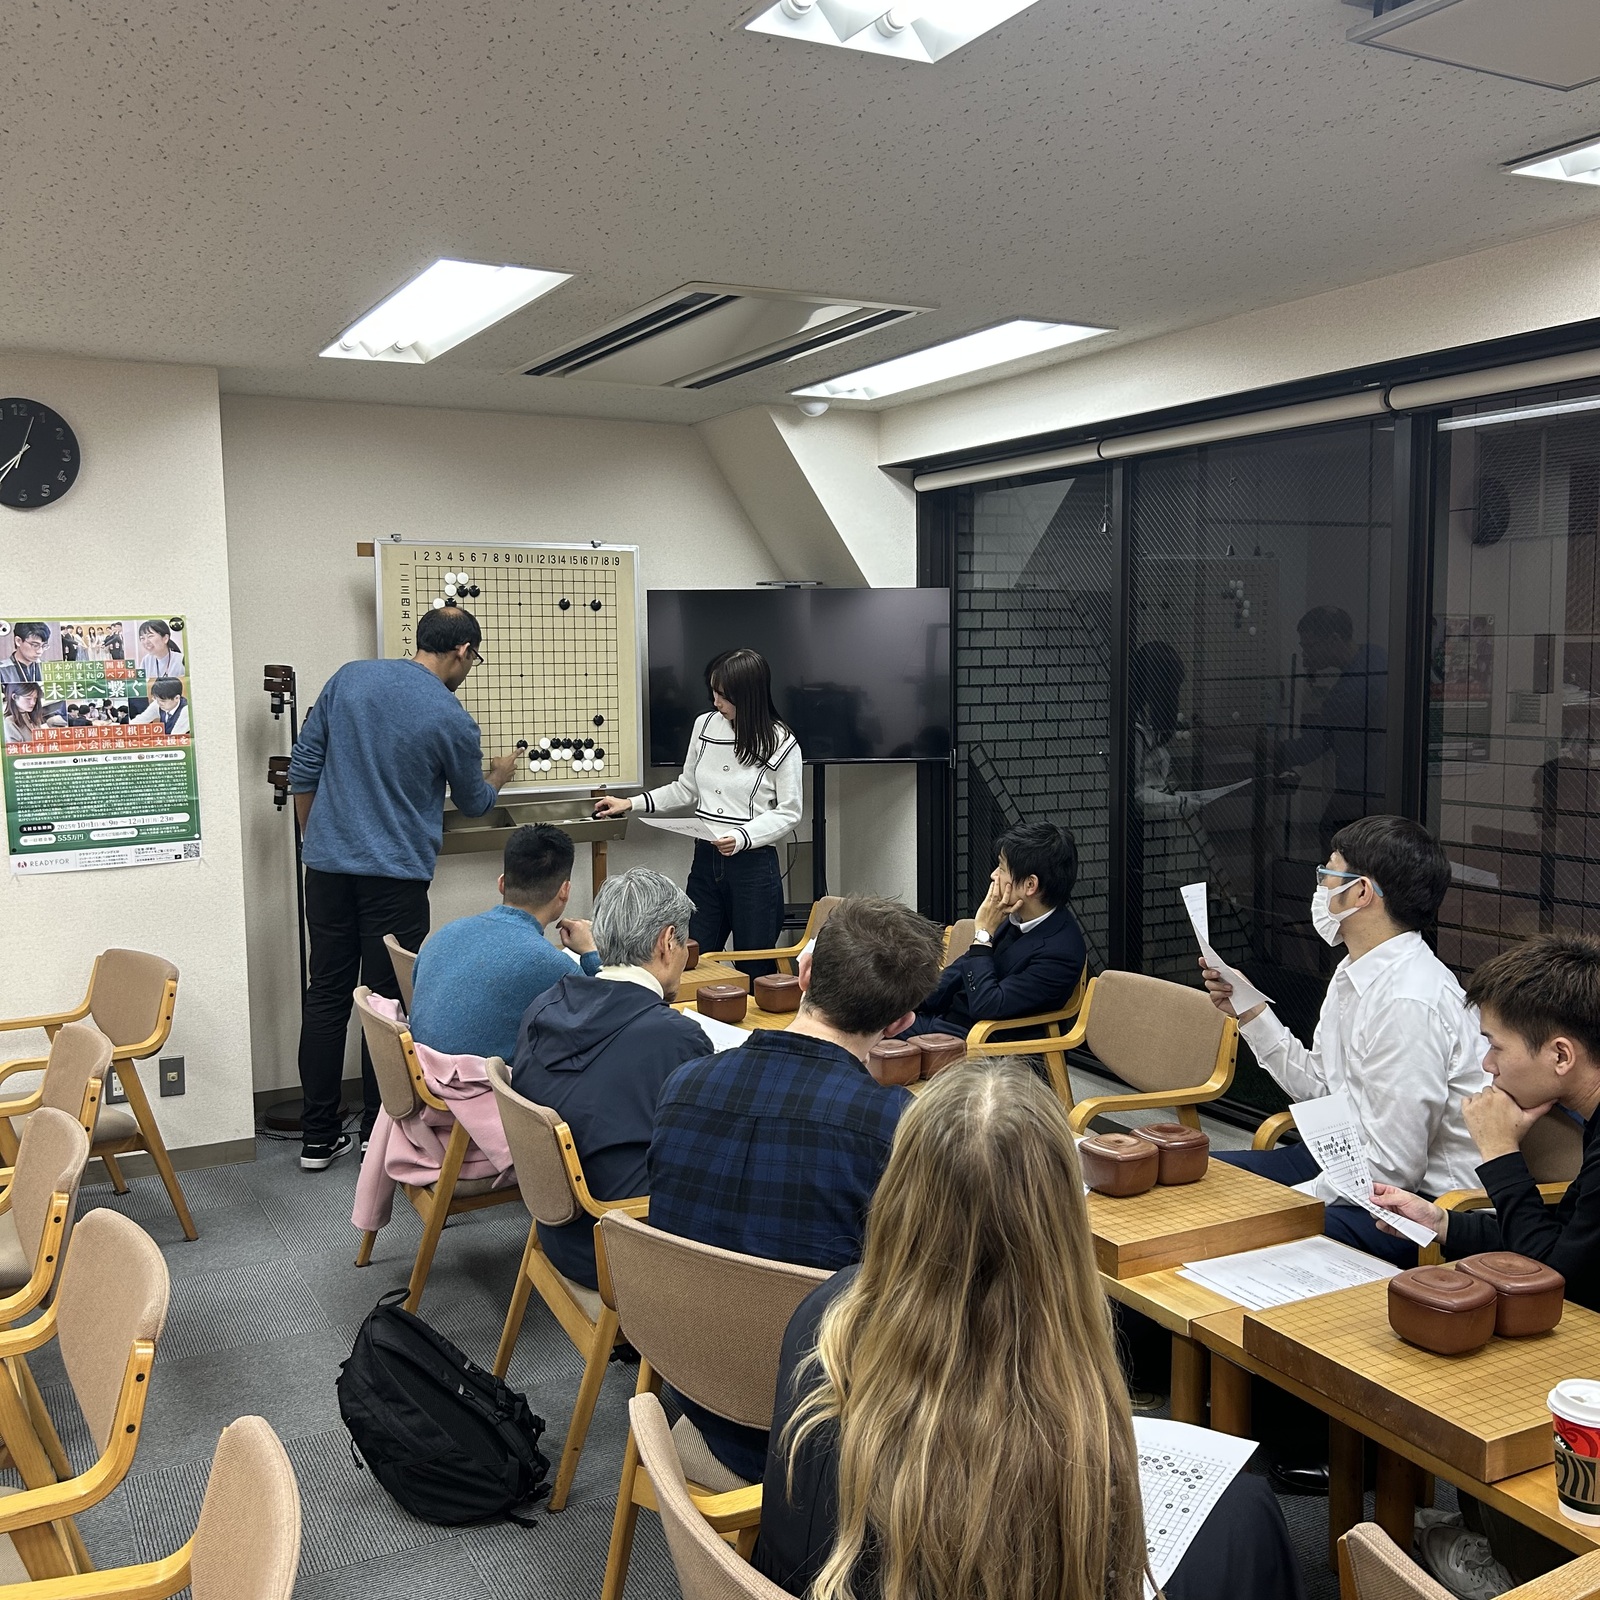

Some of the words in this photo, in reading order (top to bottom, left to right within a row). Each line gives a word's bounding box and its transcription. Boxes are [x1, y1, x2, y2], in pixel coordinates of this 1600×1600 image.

[11, 404, 28, 416] 12
[55, 427, 64, 440] 2
[62, 449, 72, 462] 3
[57, 470, 67, 482] 4
[18, 489, 28, 501] 6
[41, 484, 51, 497] 5
[424, 552, 430, 560] 2
[436, 552, 441, 561] 3
[448, 552, 452, 560] 4
[460, 552, 464, 562] 5
[471, 552, 476, 562] 6
[482, 553, 487, 562] 7
[494, 553, 499, 562] 8
[505, 553, 510, 562] 9
[515, 554, 523, 563] 10
[526, 554, 533, 563] 11
[537, 554, 545, 564] 12
[548, 555, 556, 564] 13
[558, 555, 566, 564] 14
[570, 556, 578, 564] 15
[581, 556, 588, 565] 16
[591, 556, 598, 565] 17
[602, 557, 609, 565] 18
[612, 557, 620, 566] 19
[400, 586, 410, 594] 三
[402, 598, 410, 606] 四
[402, 610, 410, 618] 五
[44, 660, 134, 671] 日本が育てた囲碁と
[44, 670, 145, 680] 日本生まれのペア碁を
[46, 680, 143, 700] 未来へ繋ぐ
[34, 725, 163, 740] 世界で活躍する棋士の
[58, 834, 84, 842] 555万円
[30, 858, 70, 867] READYFOR
